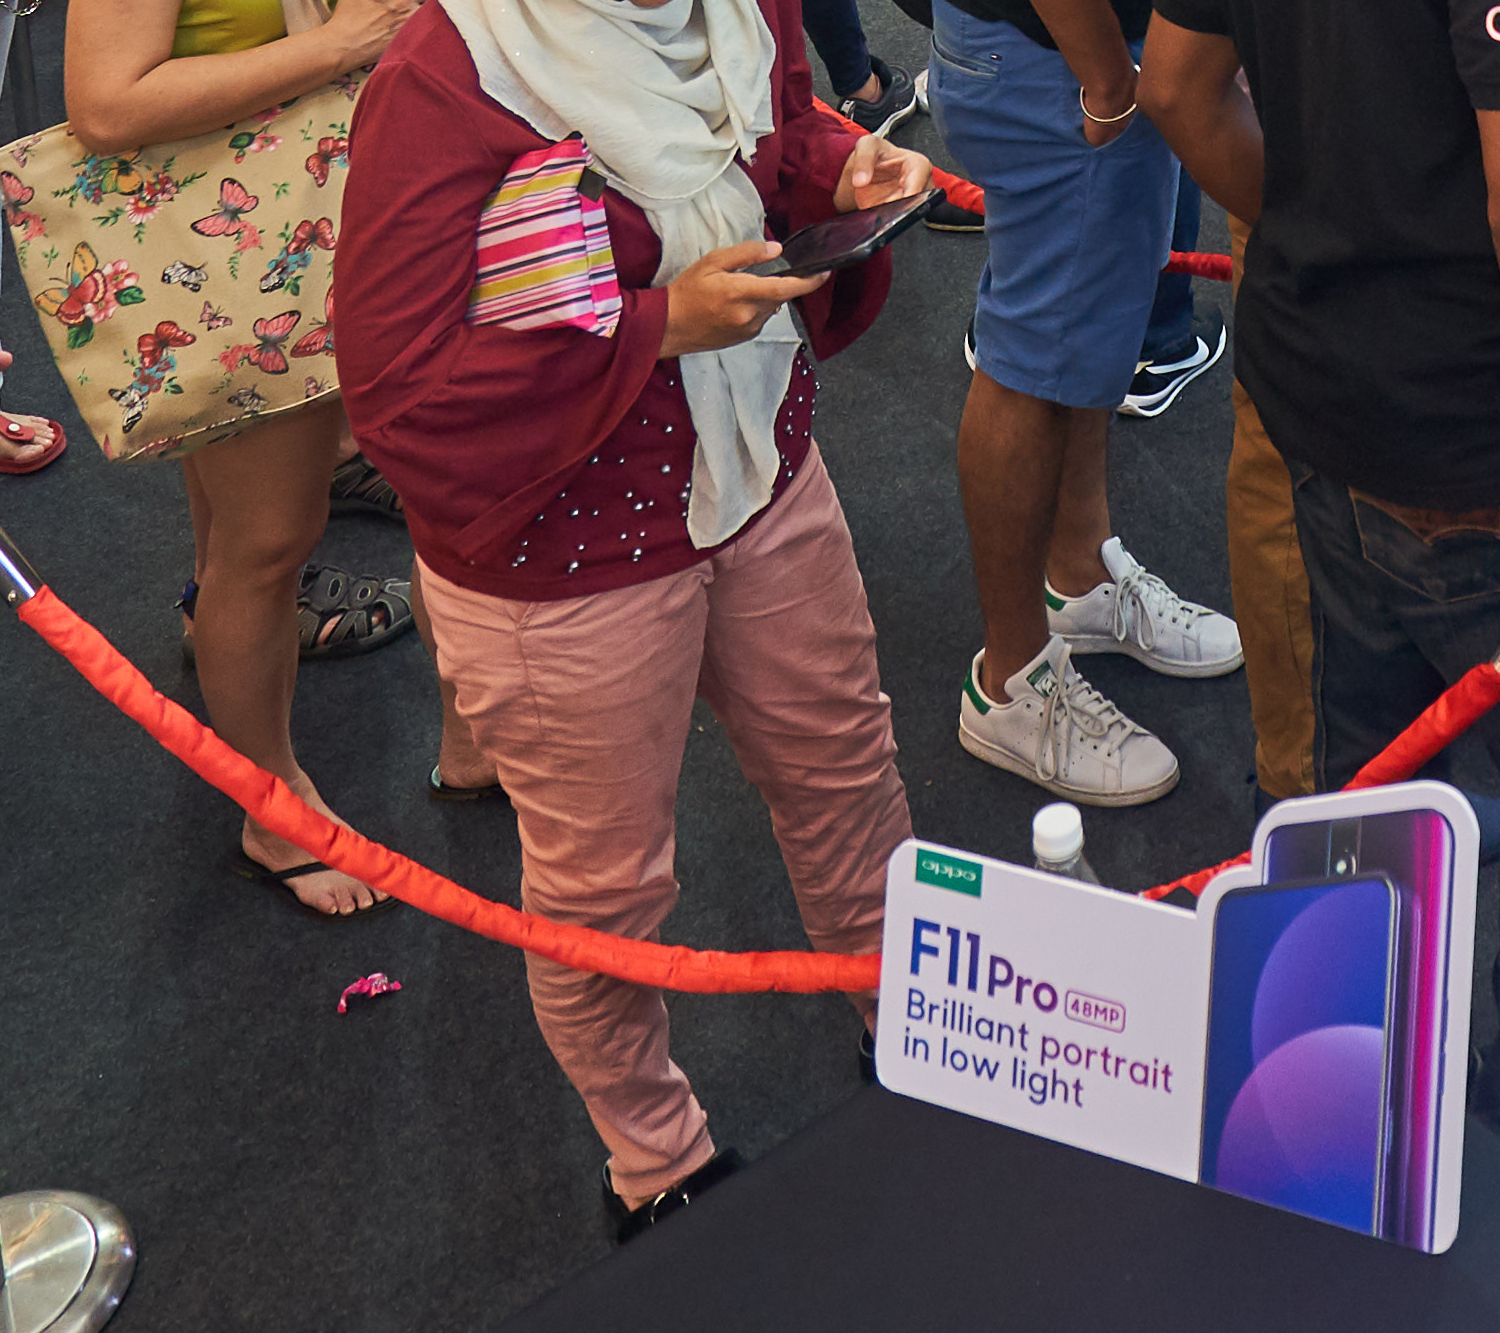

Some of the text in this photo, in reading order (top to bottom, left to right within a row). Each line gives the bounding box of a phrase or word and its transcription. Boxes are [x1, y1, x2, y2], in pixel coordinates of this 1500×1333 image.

[921, 857, 978, 883] oppo
[1070, 998, 1120, 1026] 48MP
[903, 1026, 1085, 1109] in low light
[906, 987, 1174, 1094] Brilliant portrait
